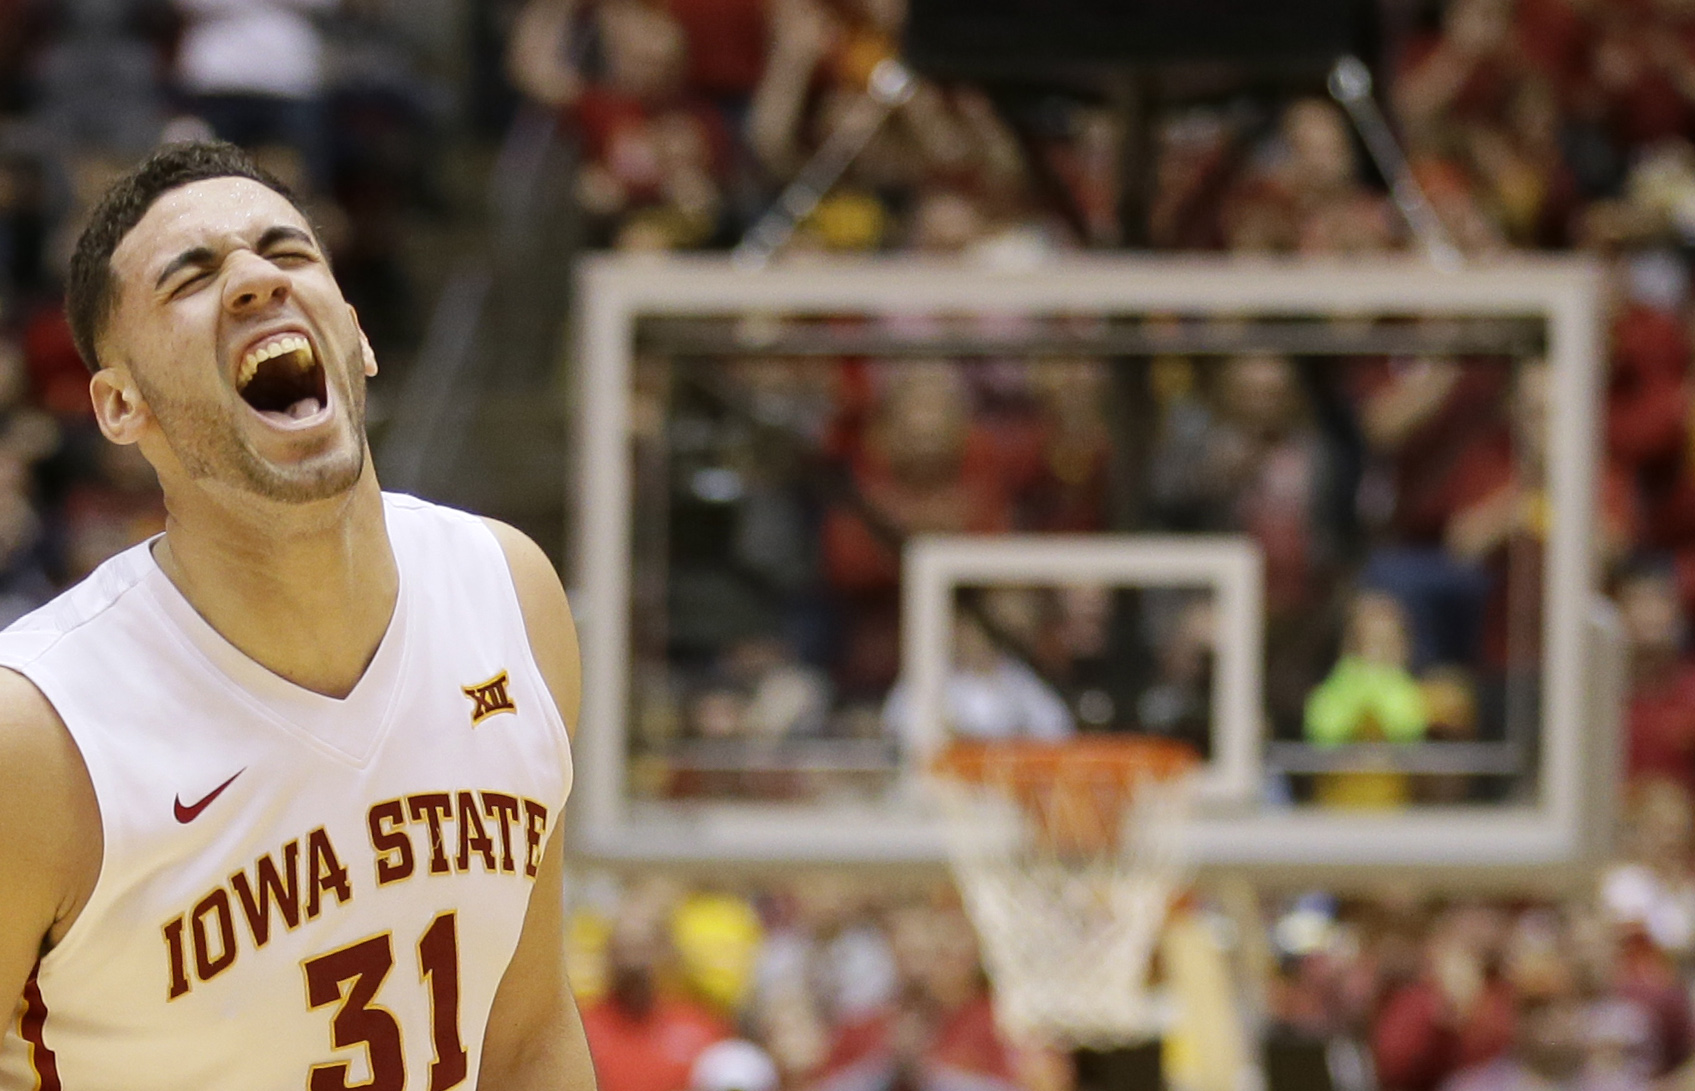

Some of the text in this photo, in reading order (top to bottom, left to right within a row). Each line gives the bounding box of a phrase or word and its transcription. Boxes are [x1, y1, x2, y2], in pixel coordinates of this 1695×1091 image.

[460, 668, 518, 730] XII
[161, 788, 549, 1003] IOWA STATE
